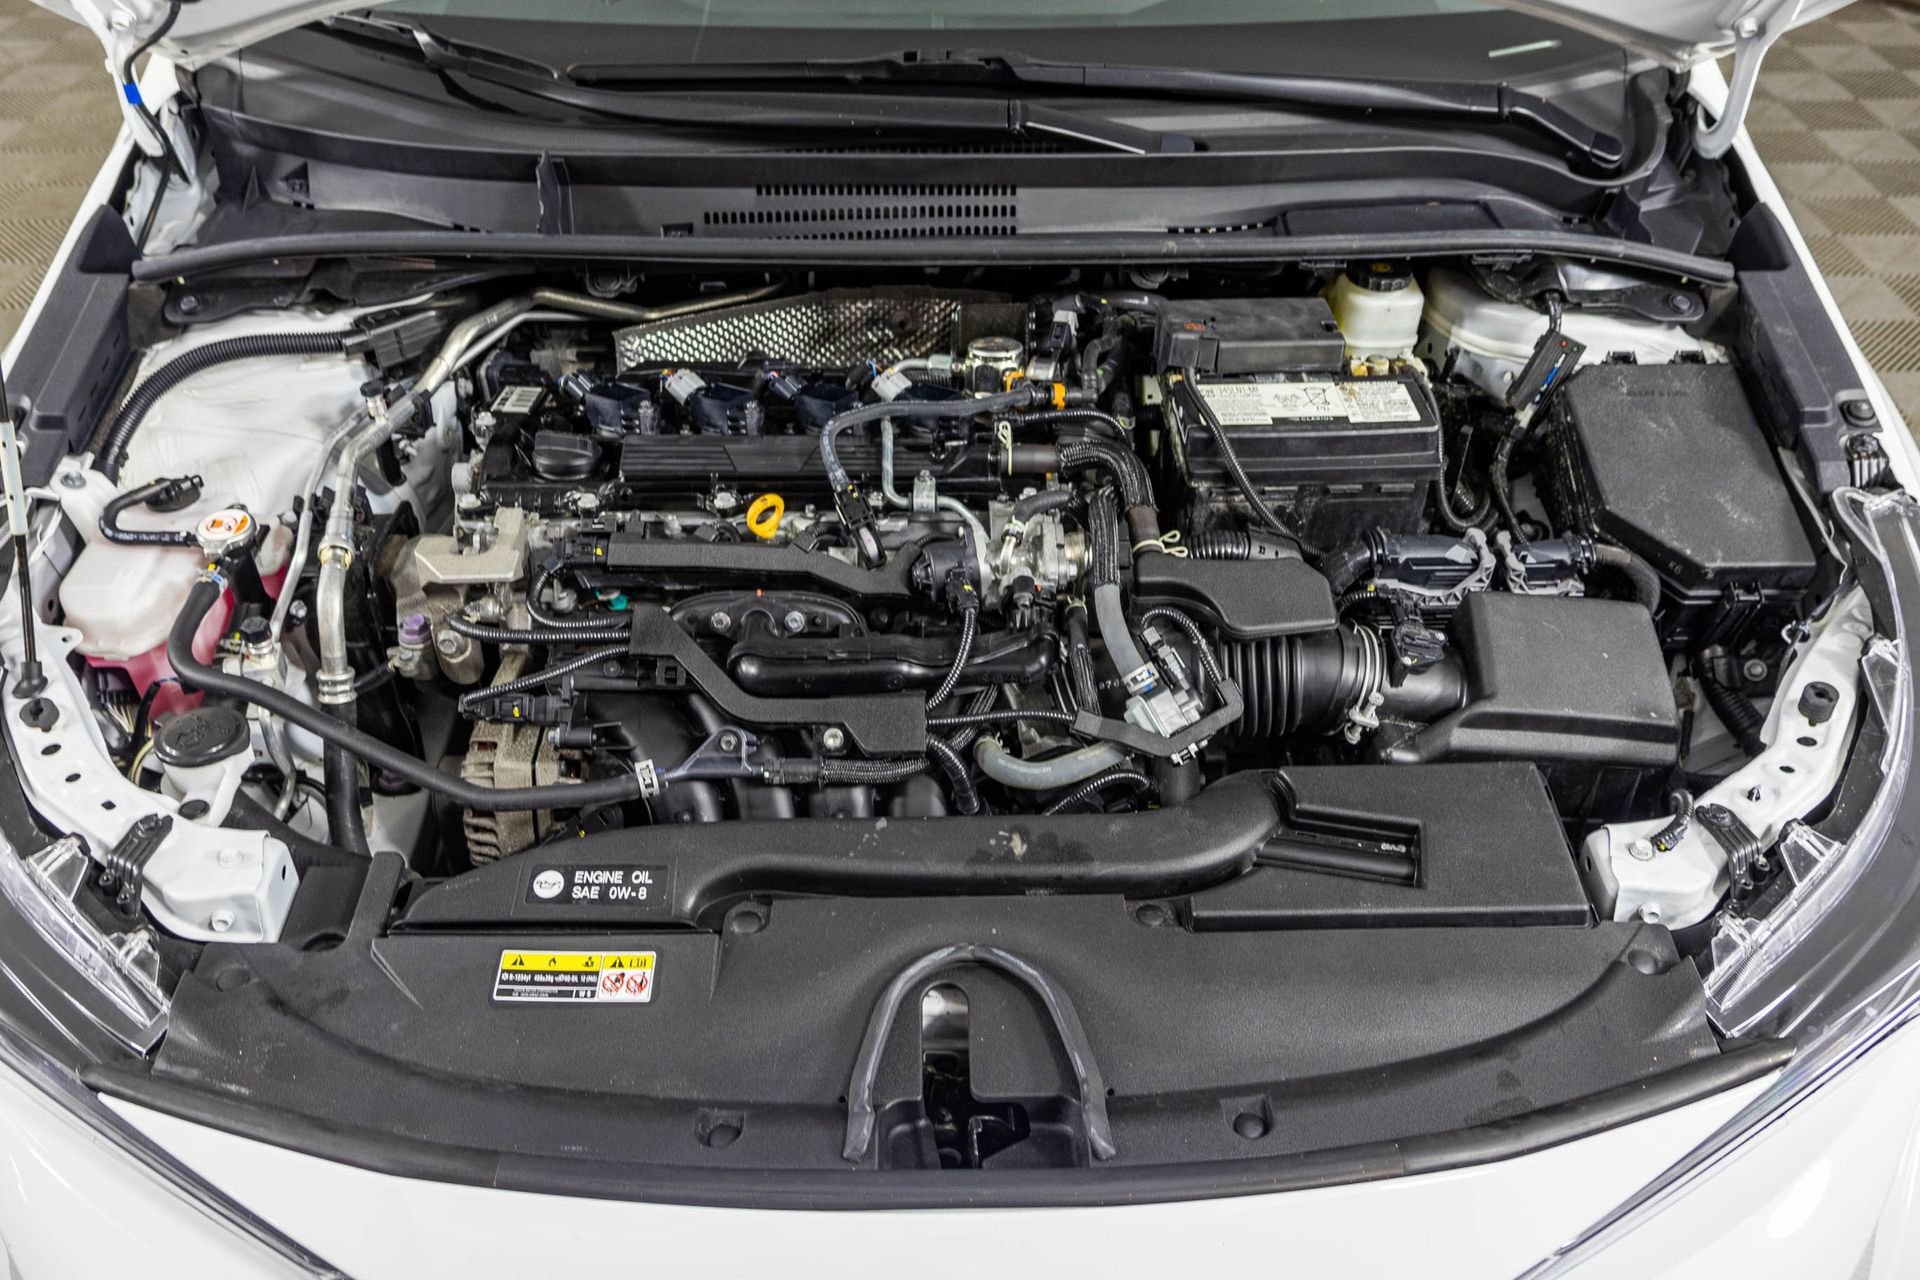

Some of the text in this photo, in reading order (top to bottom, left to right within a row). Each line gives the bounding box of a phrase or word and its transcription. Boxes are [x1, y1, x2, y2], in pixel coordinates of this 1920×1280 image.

[574, 870, 653, 884] ENGINE OIL
[571, 885, 647, 900] SAE 0W-8
